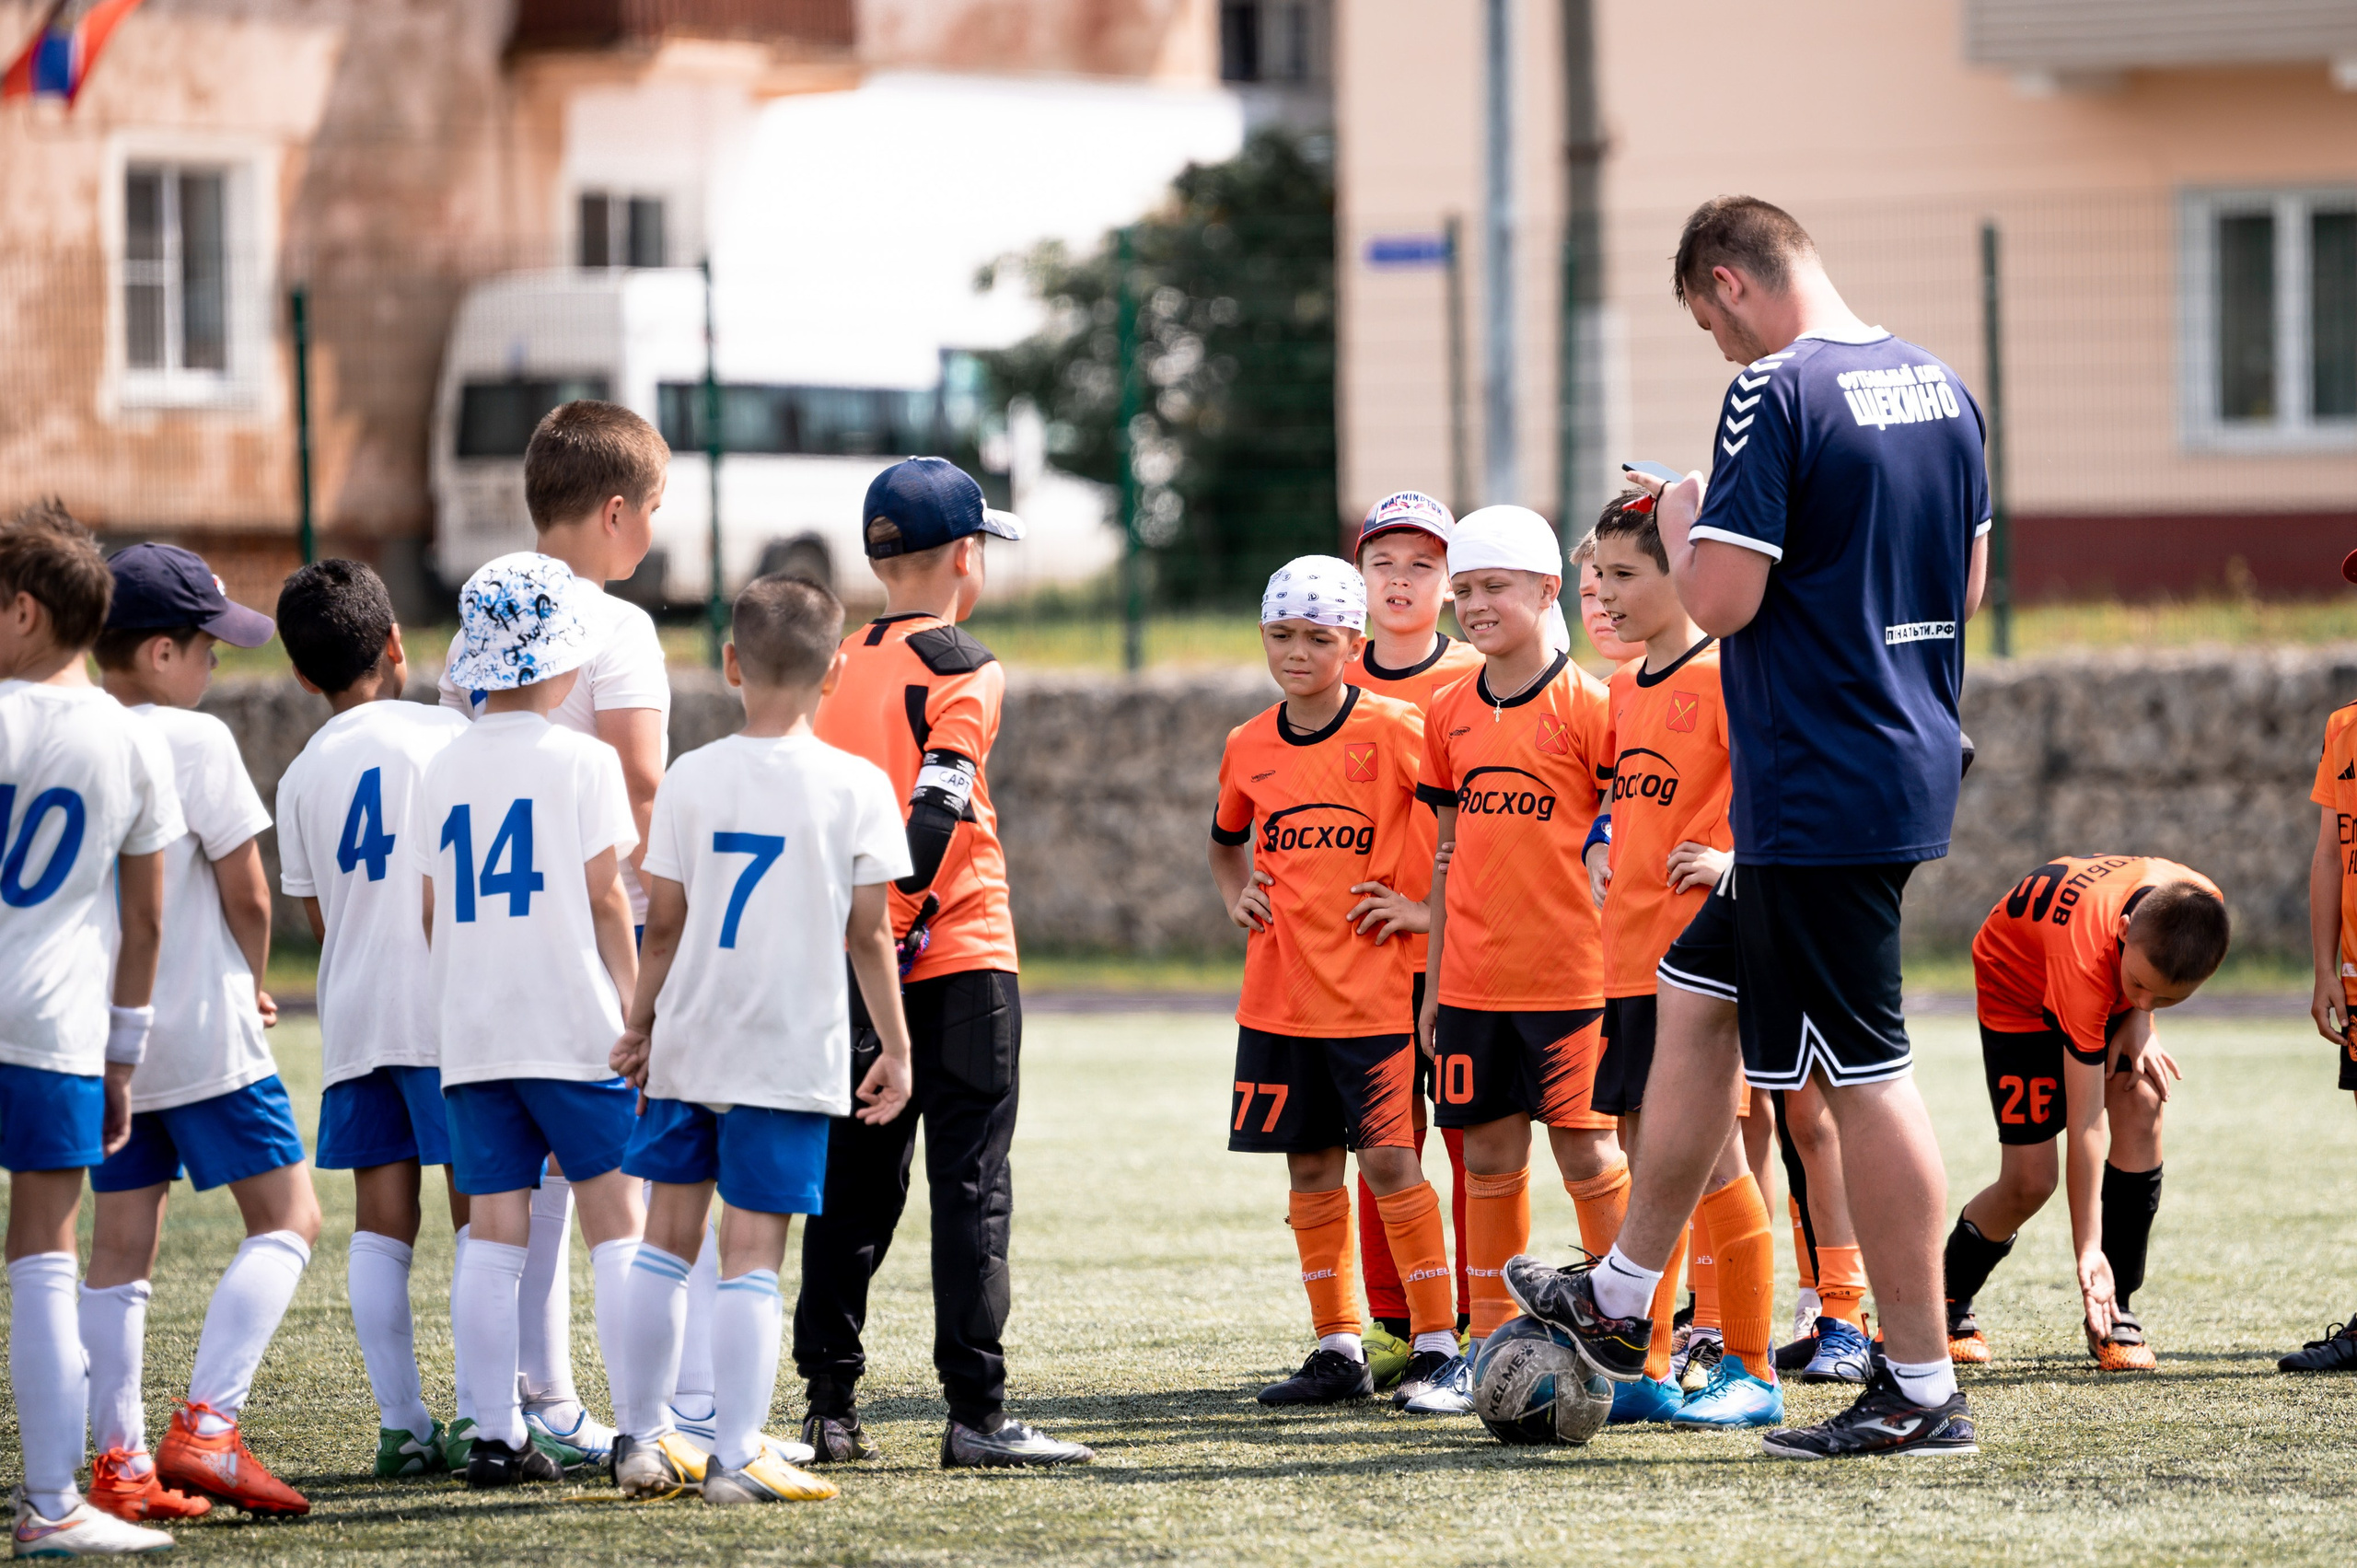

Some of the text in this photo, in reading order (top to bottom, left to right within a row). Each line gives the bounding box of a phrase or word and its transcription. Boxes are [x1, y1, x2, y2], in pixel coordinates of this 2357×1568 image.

[1844, 382, 1960, 431] ЩЕКИНО
[337, 766, 396, 882] 4
[440, 798, 544, 923] 14
[713, 831, 786, 949] 7
[1235, 1081, 1288, 1132] 77
[1434, 1054, 1474, 1104] 10
[1999, 1074, 2058, 1124] 26
[1489, 1353, 1526, 1416] KELME
